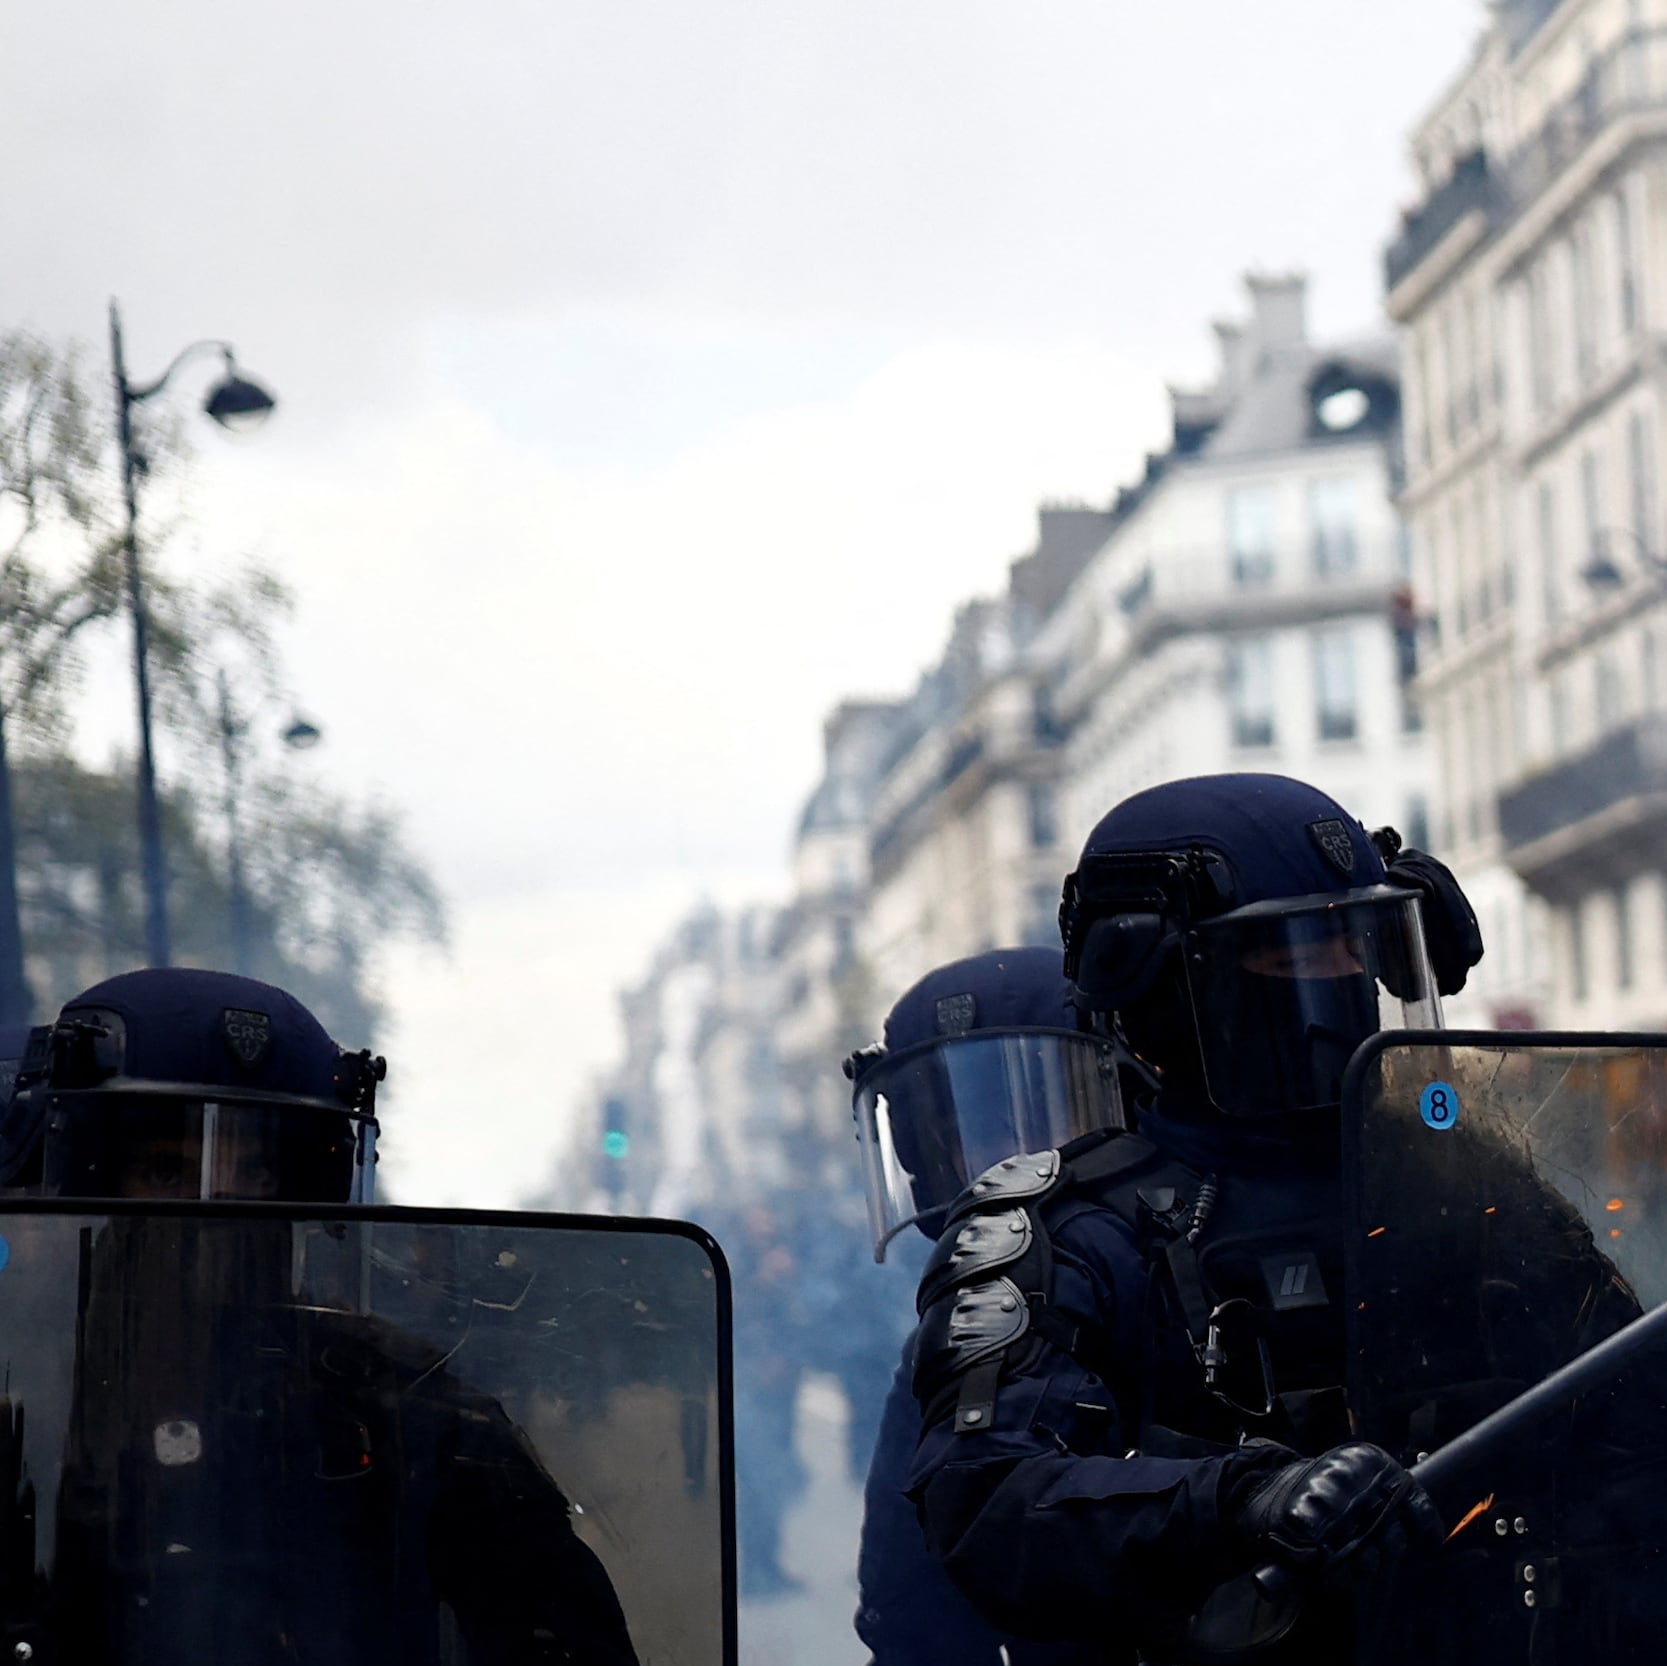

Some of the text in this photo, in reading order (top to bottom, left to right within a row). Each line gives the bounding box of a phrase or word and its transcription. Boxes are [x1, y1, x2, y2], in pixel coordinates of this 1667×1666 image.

[1322, 834, 1351, 850] CRS
[227, 1023, 269, 1042] CRS
[1431, 1089, 1449, 1123] 8
